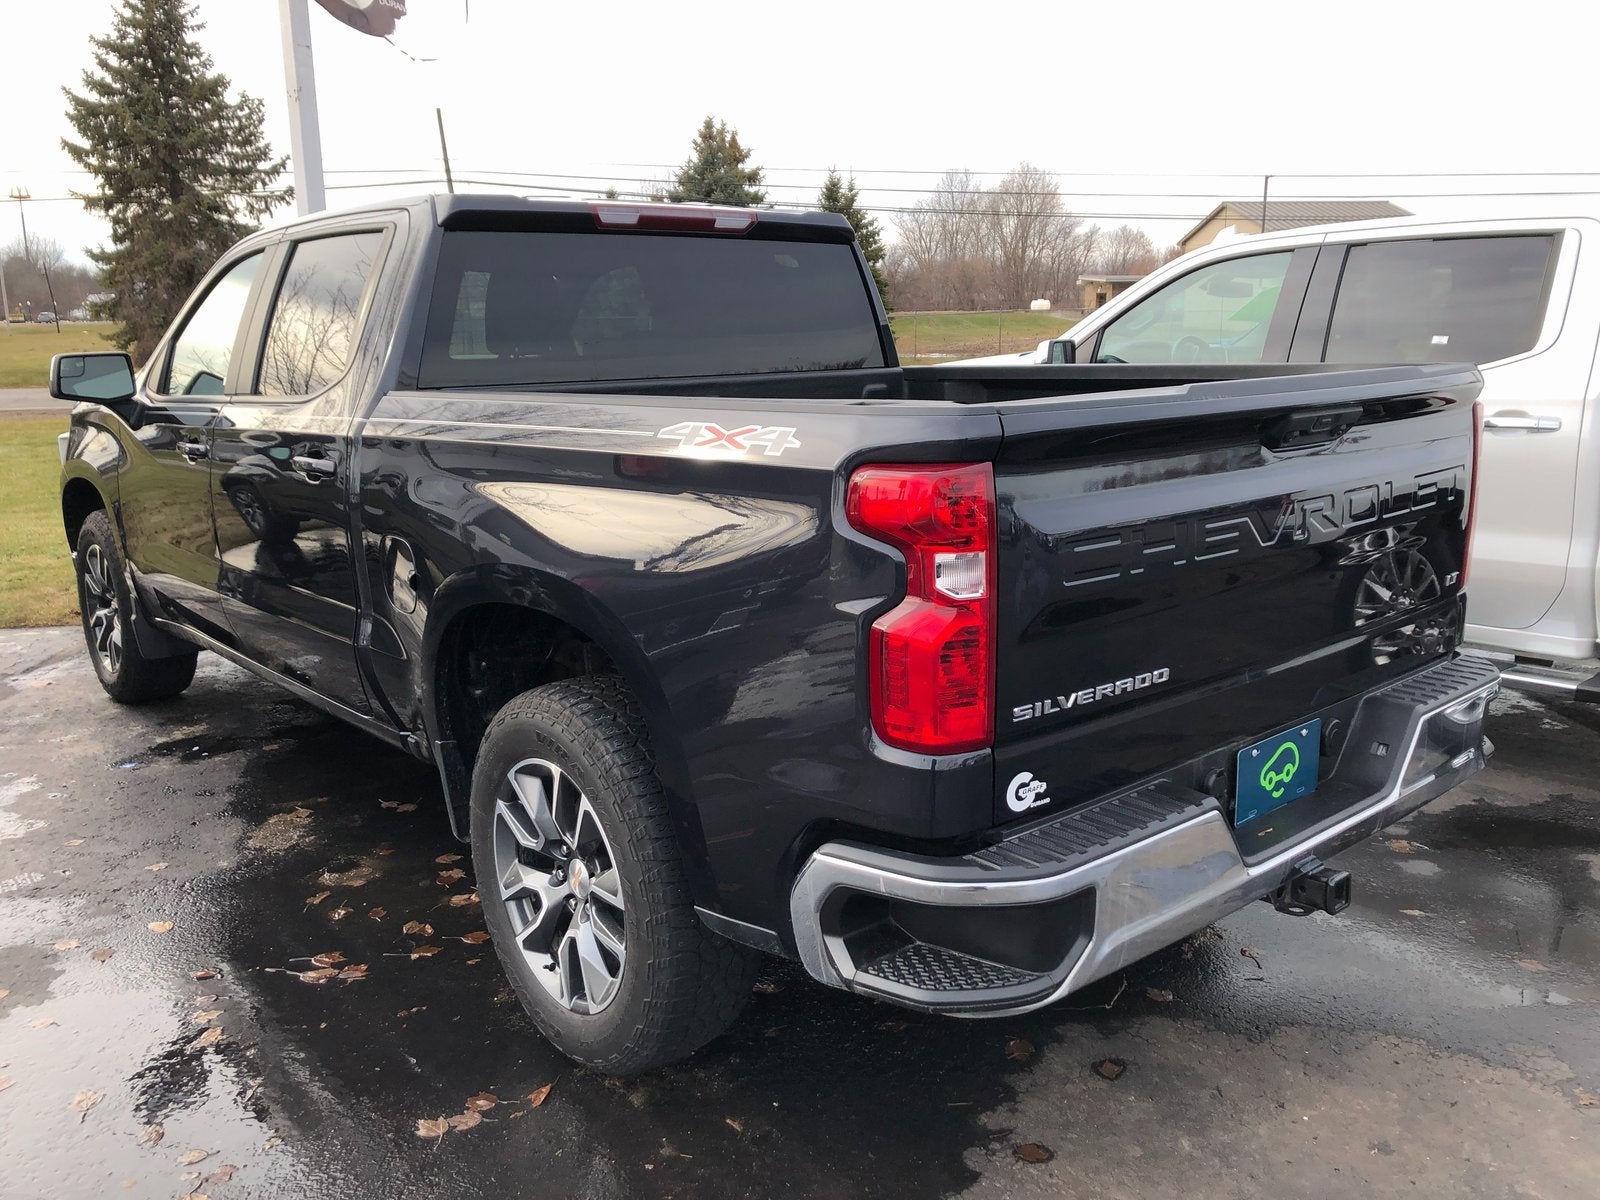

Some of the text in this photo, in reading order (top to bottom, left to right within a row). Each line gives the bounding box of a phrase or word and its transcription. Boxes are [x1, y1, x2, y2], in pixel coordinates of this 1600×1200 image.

[1063, 464, 1466, 587] CHEVROLET
[1012, 667, 1170, 723] SILVERADO
[1022, 784, 1045, 795] GRAFF
